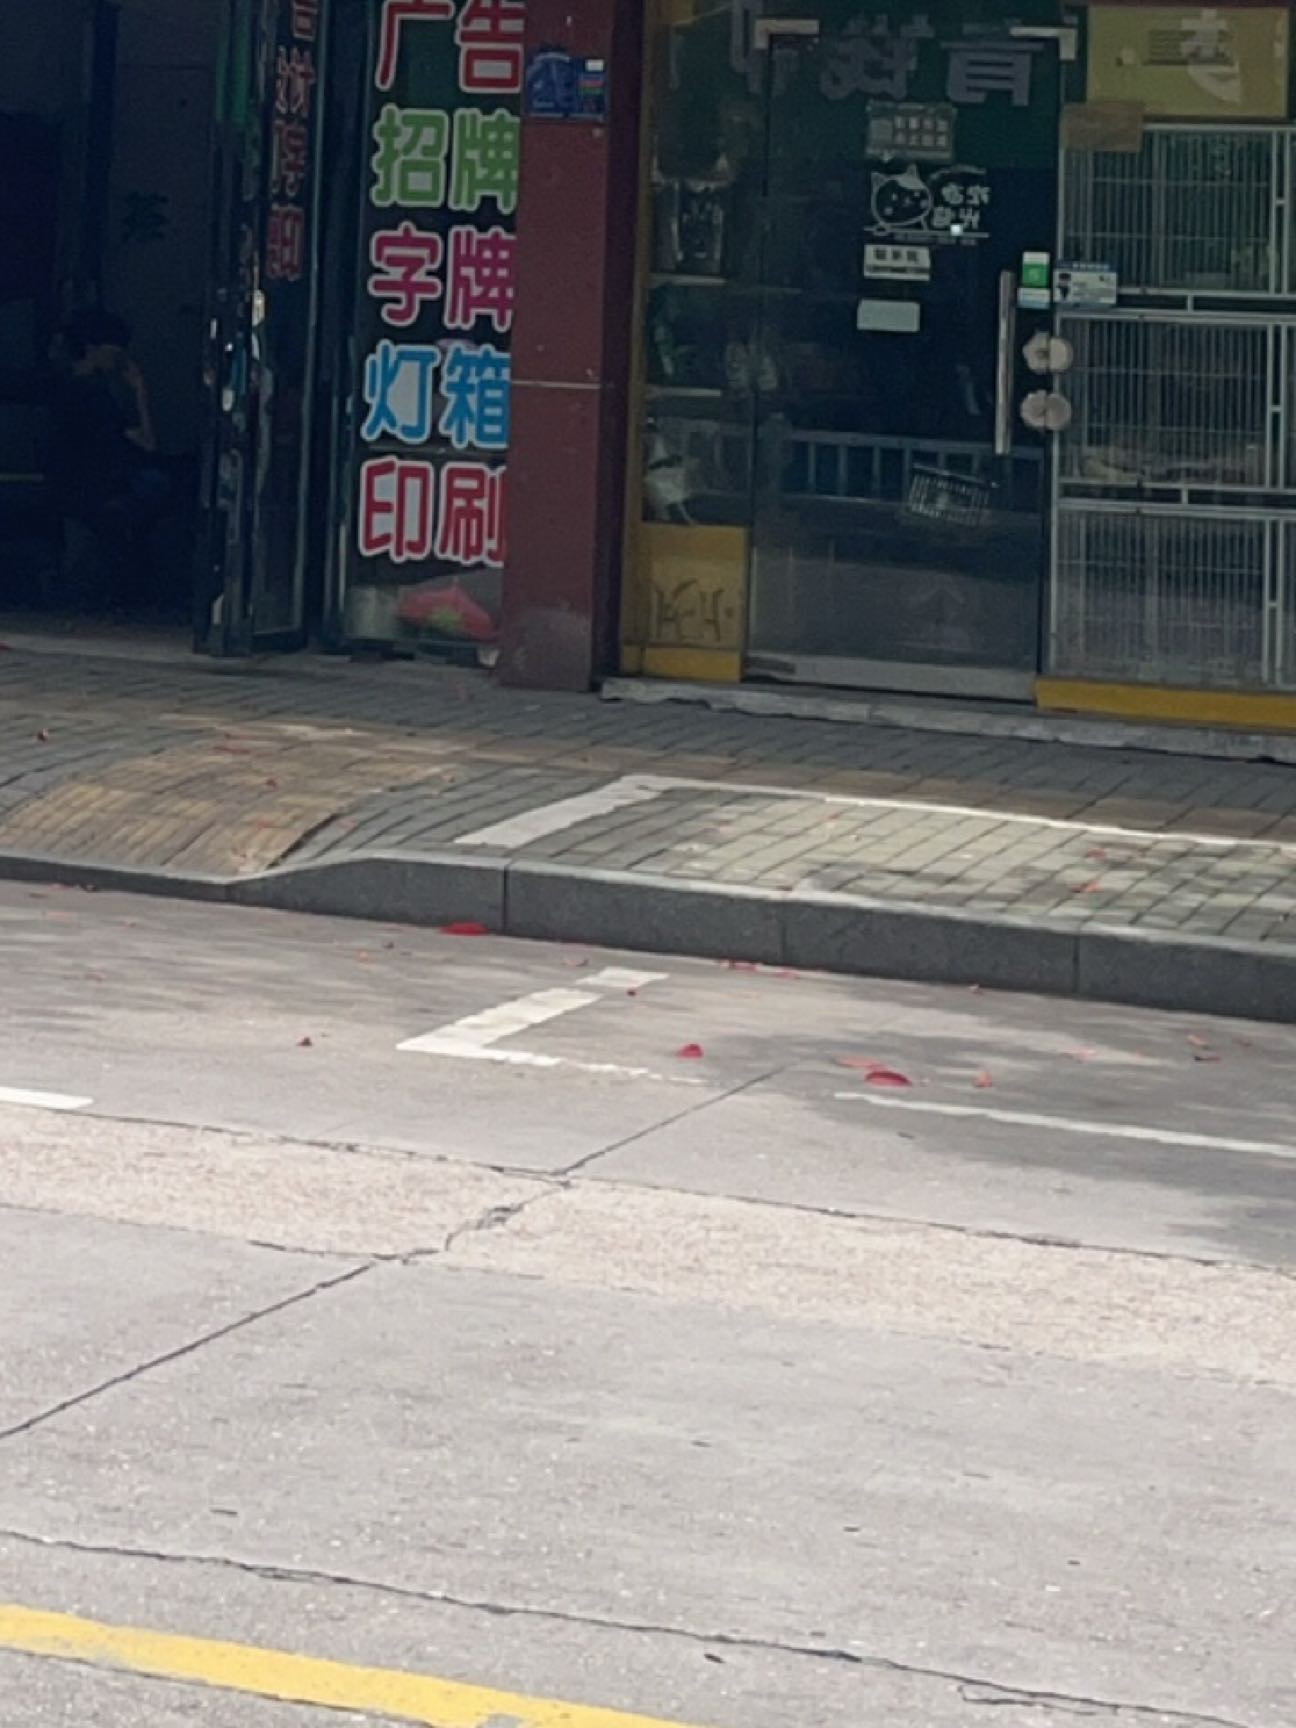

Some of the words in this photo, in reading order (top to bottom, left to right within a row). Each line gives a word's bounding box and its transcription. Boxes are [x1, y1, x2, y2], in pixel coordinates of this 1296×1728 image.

[368, 103, 522, 215] 招牌
[366, 221, 517, 333] 字牌
[360, 338, 512, 448] 灯箱
[358, 454, 507, 568] 印刷
